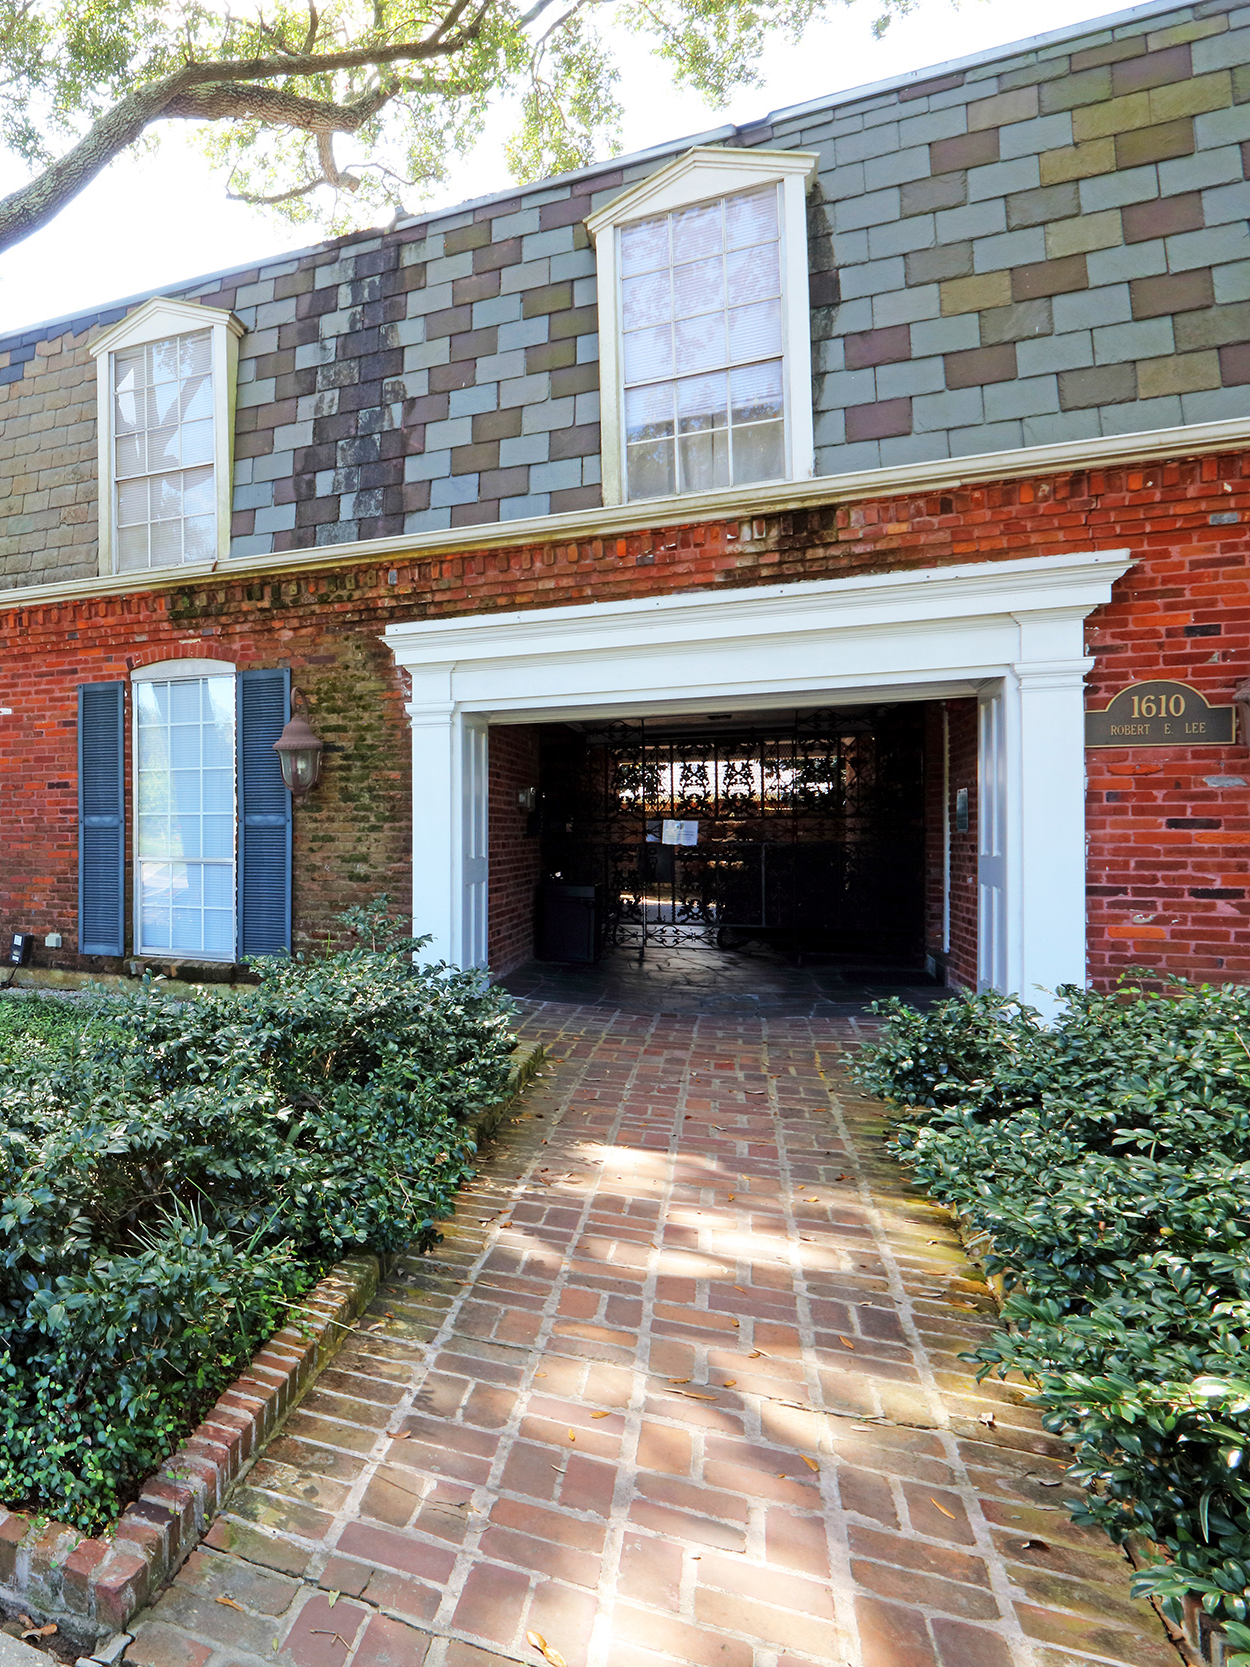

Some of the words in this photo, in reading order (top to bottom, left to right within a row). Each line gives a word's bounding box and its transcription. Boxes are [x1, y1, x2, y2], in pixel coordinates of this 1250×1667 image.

[1131, 694, 1186, 718] 1610
[1110, 724, 1150, 736] ROBERT
[1164, 723, 1174, 735] E.
[1185, 722, 1206, 734] LEE
